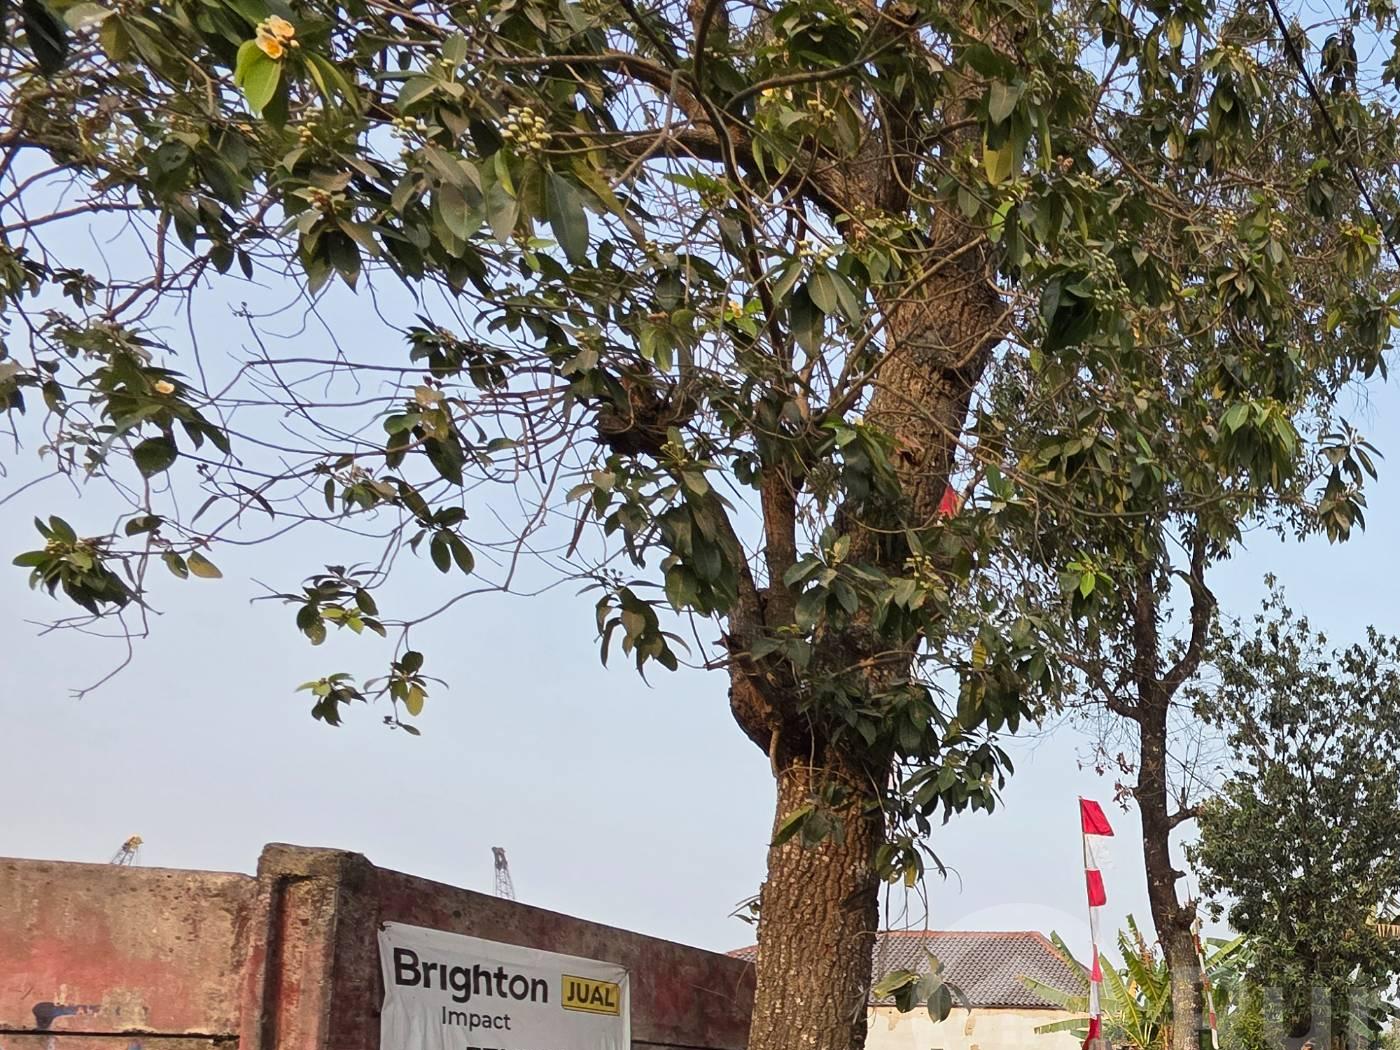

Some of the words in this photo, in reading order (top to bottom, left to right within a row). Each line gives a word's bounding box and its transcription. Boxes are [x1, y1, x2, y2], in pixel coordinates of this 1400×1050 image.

[392, 947, 549, 1004] Brighton
[566, 980, 616, 1008] JUAL
[441, 1006, 512, 1032] Impact
